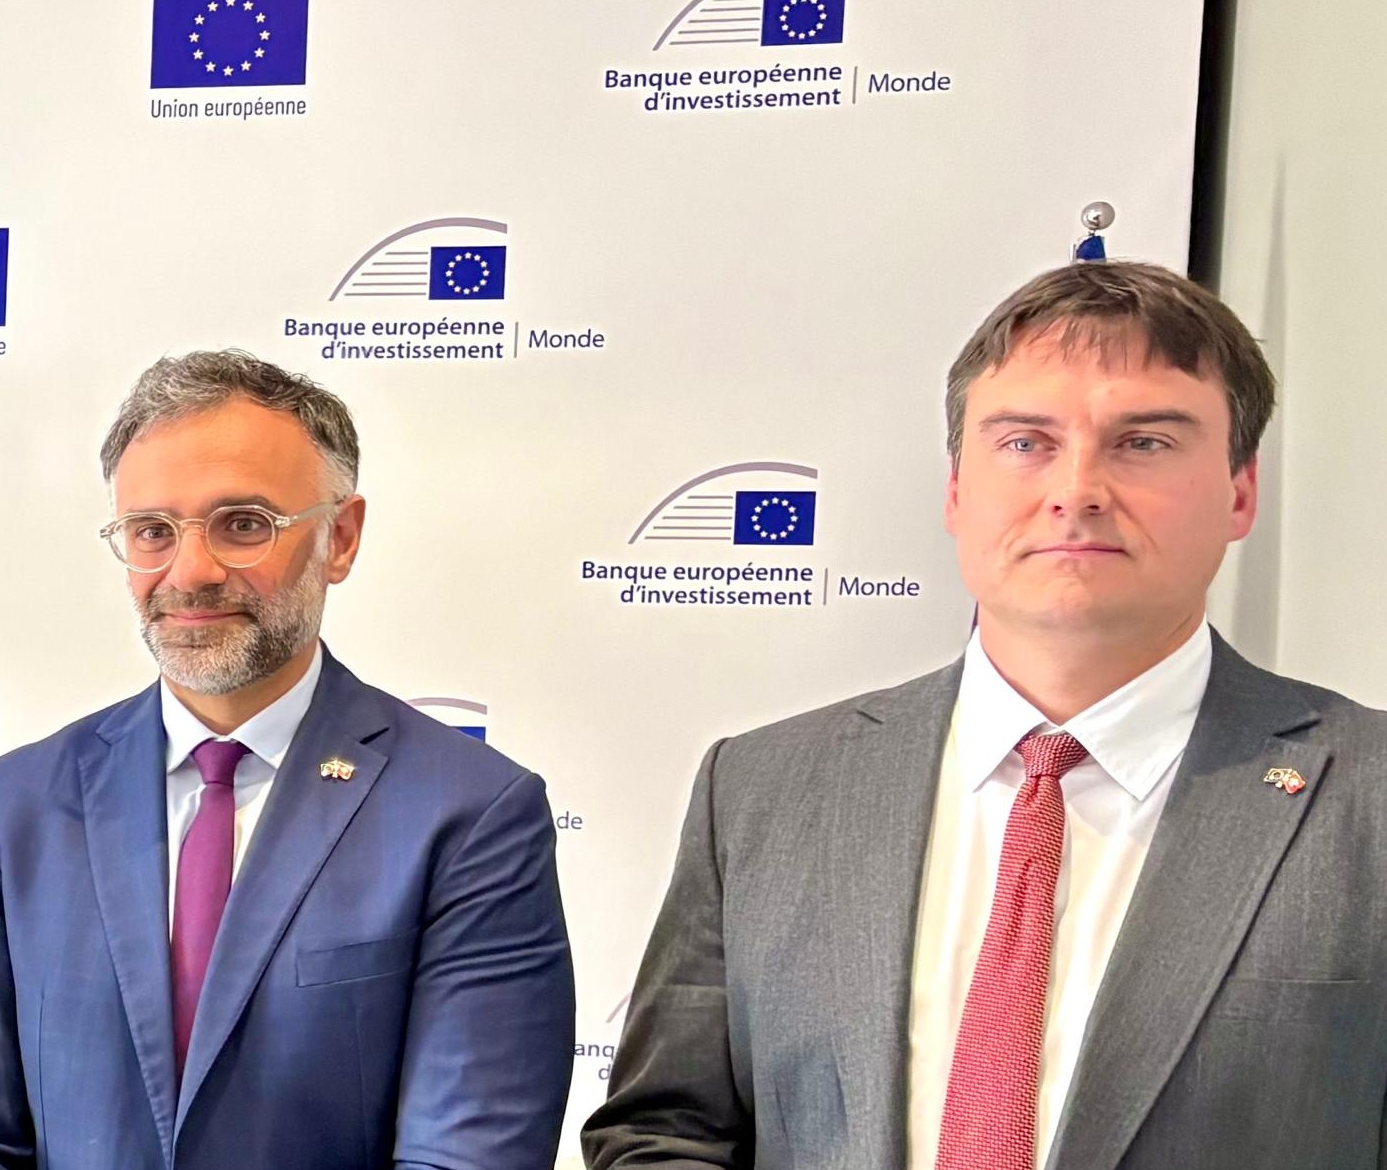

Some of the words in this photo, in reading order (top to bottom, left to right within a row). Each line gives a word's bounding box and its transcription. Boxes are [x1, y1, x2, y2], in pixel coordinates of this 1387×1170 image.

[604, 69, 693, 92] Banque
[698, 63, 843, 88] européenne
[868, 70, 951, 94] Monde
[150, 98, 199, 119] Union
[204, 97, 307, 121] européenne
[643, 86, 841, 112] d'investissement
[284, 318, 366, 341] Banque
[371, 317, 505, 341] européenne
[528, 328, 605, 349] Monde
[321, 341, 504, 360] d'investissement
[582, 560, 668, 584] Banque
[673, 562, 814, 585] européenne
[620, 583, 813, 606] d'investissement
[838, 575, 920, 597] Monde
